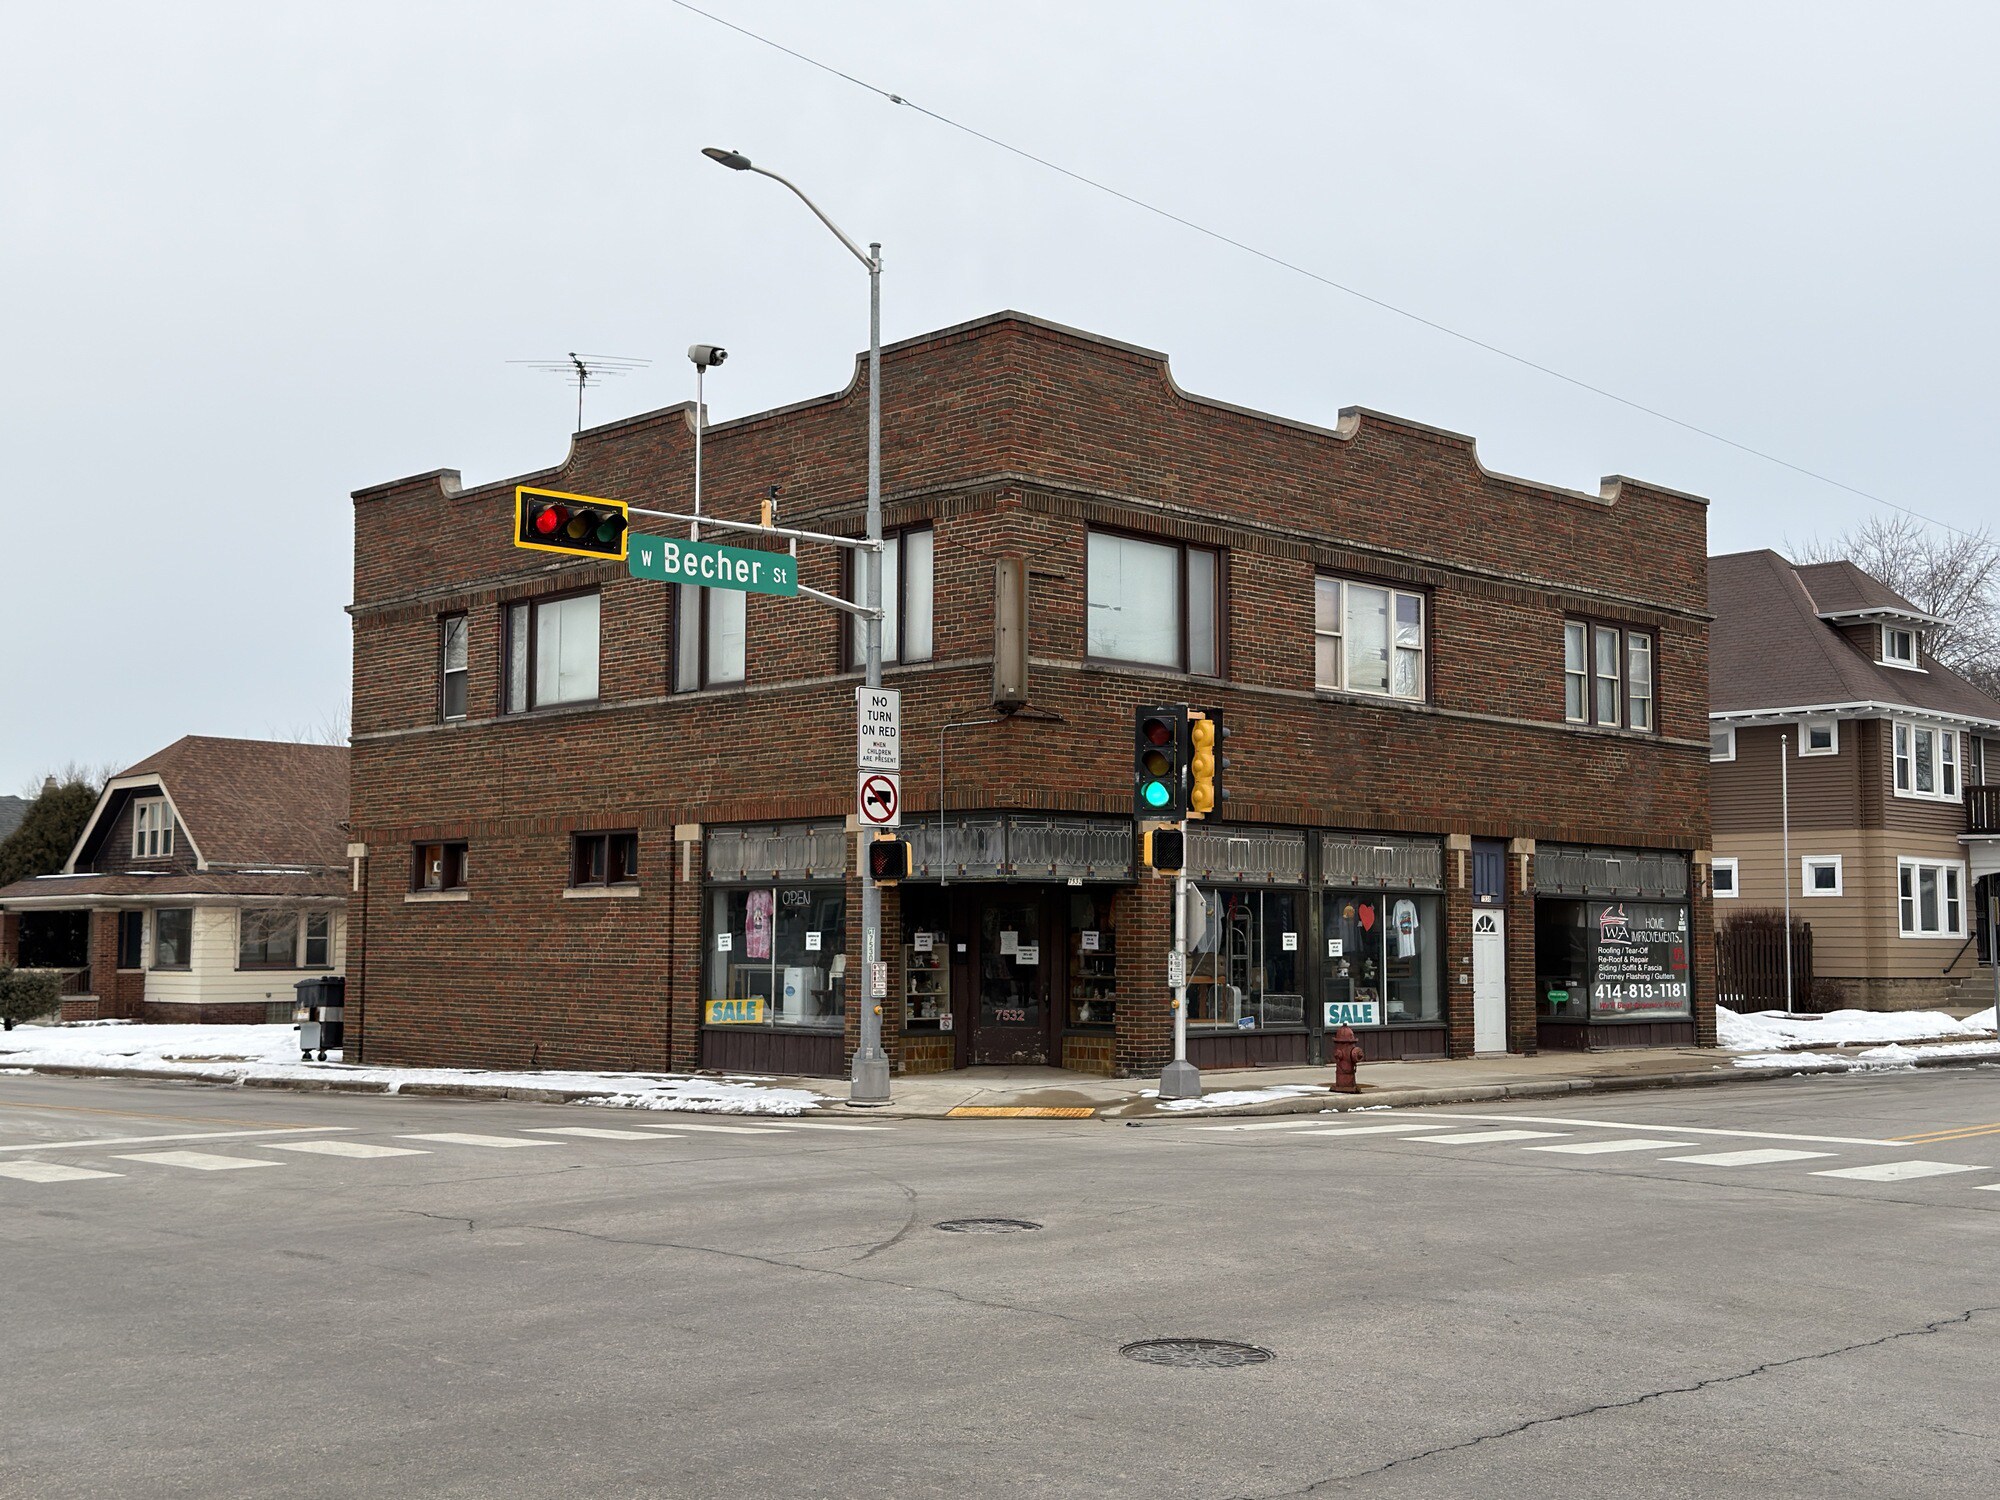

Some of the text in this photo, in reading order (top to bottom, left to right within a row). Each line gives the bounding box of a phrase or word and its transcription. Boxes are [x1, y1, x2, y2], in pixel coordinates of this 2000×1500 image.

[641, 542, 787, 584] W Becher St
[872, 696, 888, 707] NO
[867, 710, 892, 722] TURN
[862, 724, 896, 738] ON RED
[867, 748, 892, 756] CHILDREN
[874, 756, 896, 764] PRESENT
[782, 890, 811, 905] OPEN
[1645, 917, 1665, 929] HOME
[1631, 931, 1679, 943] IMPROVEMENTS
[1598, 946, 1620, 955] Roofing
[1625, 946, 1649, 954] Tear-Off
[1630, 956, 1649, 964] Repair
[1599, 964, 1617, 972] Siding
[1599, 973, 1625, 981] Chimney
[1626, 973, 1650, 981] Flashing
[1595, 983, 1687, 998] 414-813-1181
[711, 1001, 757, 1021] SALE
[995, 1009, 1025, 1021] 7532
[1329, 1004, 1372, 1024] SALE
